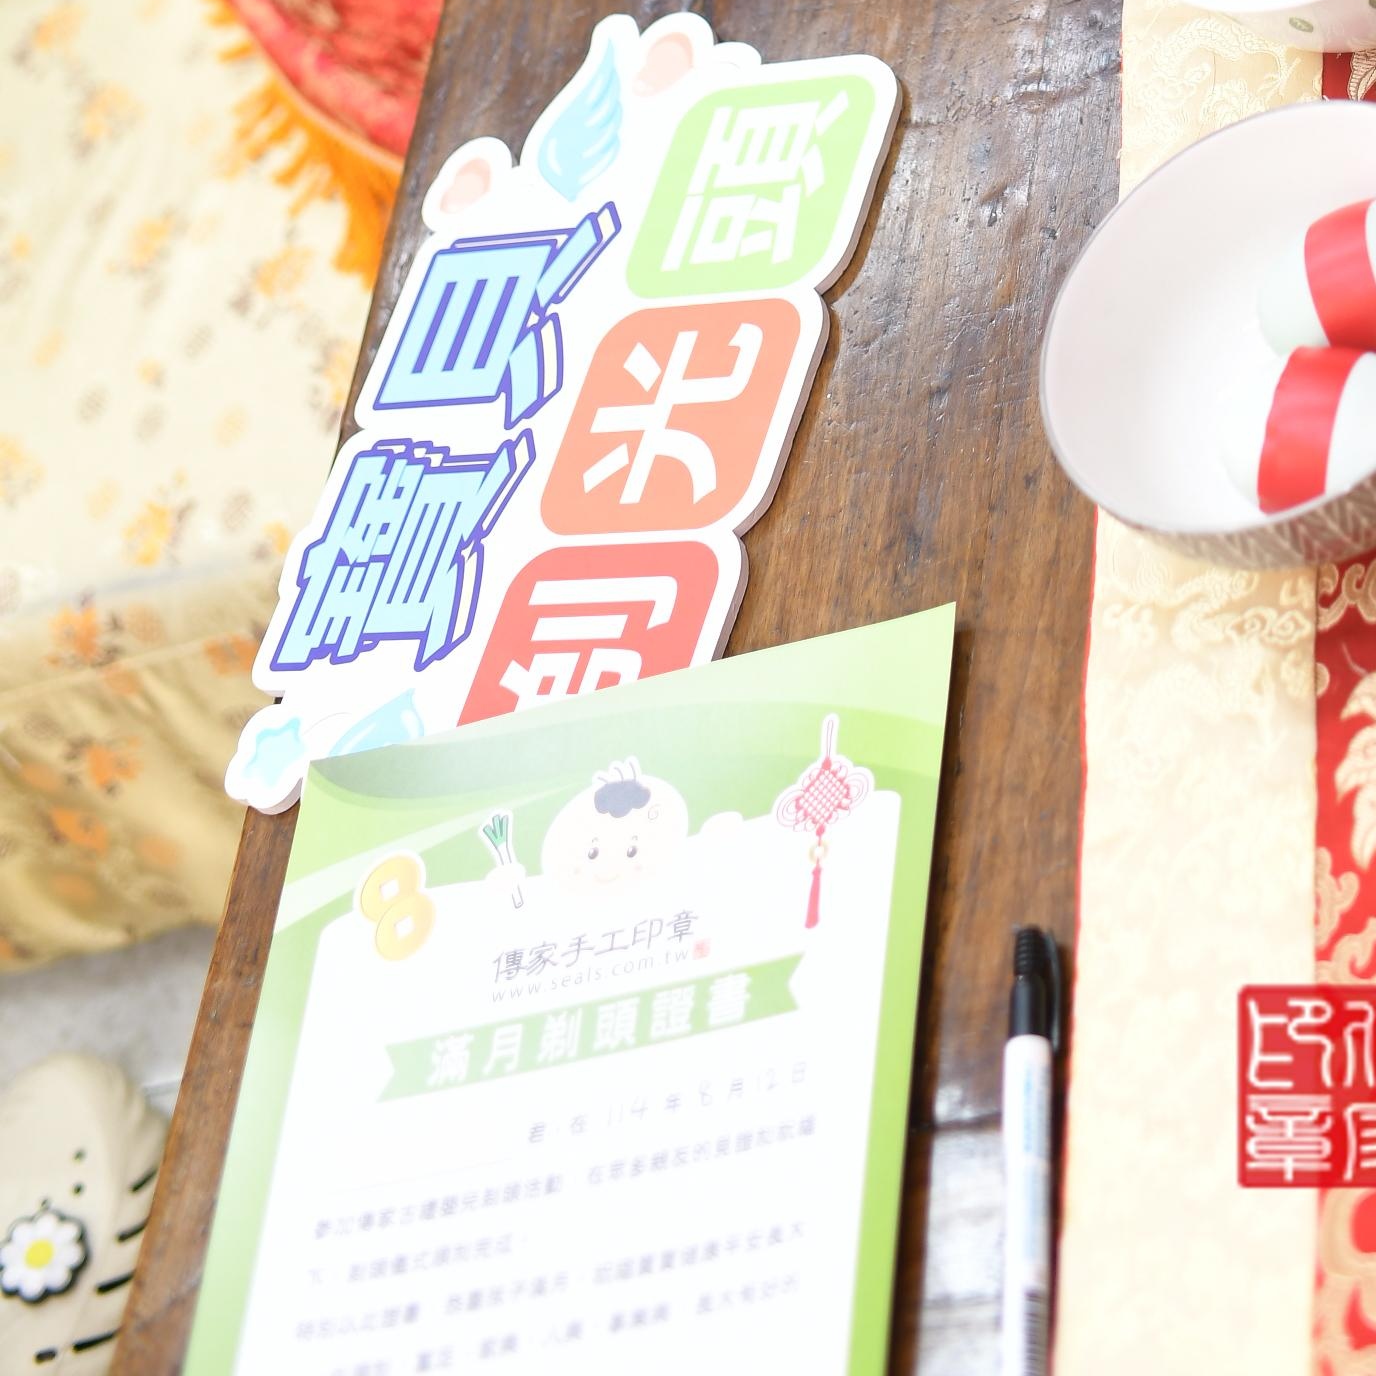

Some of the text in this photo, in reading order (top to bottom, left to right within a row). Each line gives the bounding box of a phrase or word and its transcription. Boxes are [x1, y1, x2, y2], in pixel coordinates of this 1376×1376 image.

[270, 201, 622, 672] 寶貝
[491, 948, 689, 1003] www.seals.com.tw
[492, 909, 699, 983] 傳家手工印章
[425, 971, 753, 1089] 滿月剃頭證書
